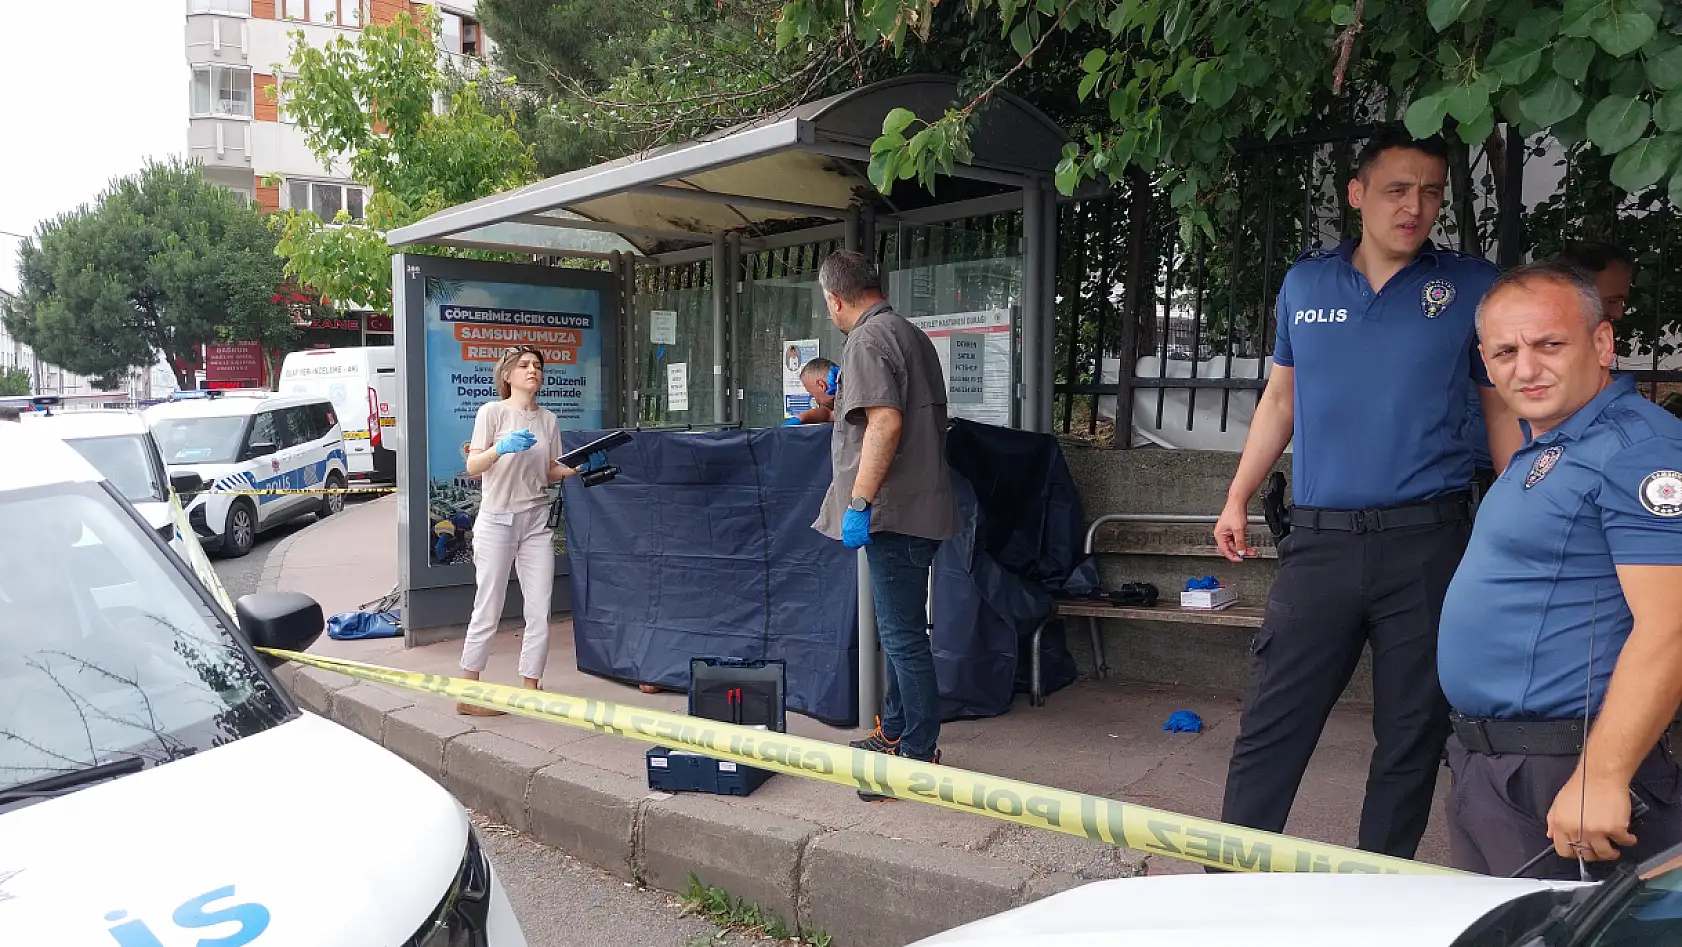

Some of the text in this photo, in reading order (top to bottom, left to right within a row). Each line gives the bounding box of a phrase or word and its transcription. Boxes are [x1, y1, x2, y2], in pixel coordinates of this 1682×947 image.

[445, 308, 589, 327] ÇÖPLERİMİZ ÇİÇEK OLUYOR
[461, 327, 577, 343] SAMSUN'UMUZA
[547, 376, 587, 387] Düzenli
